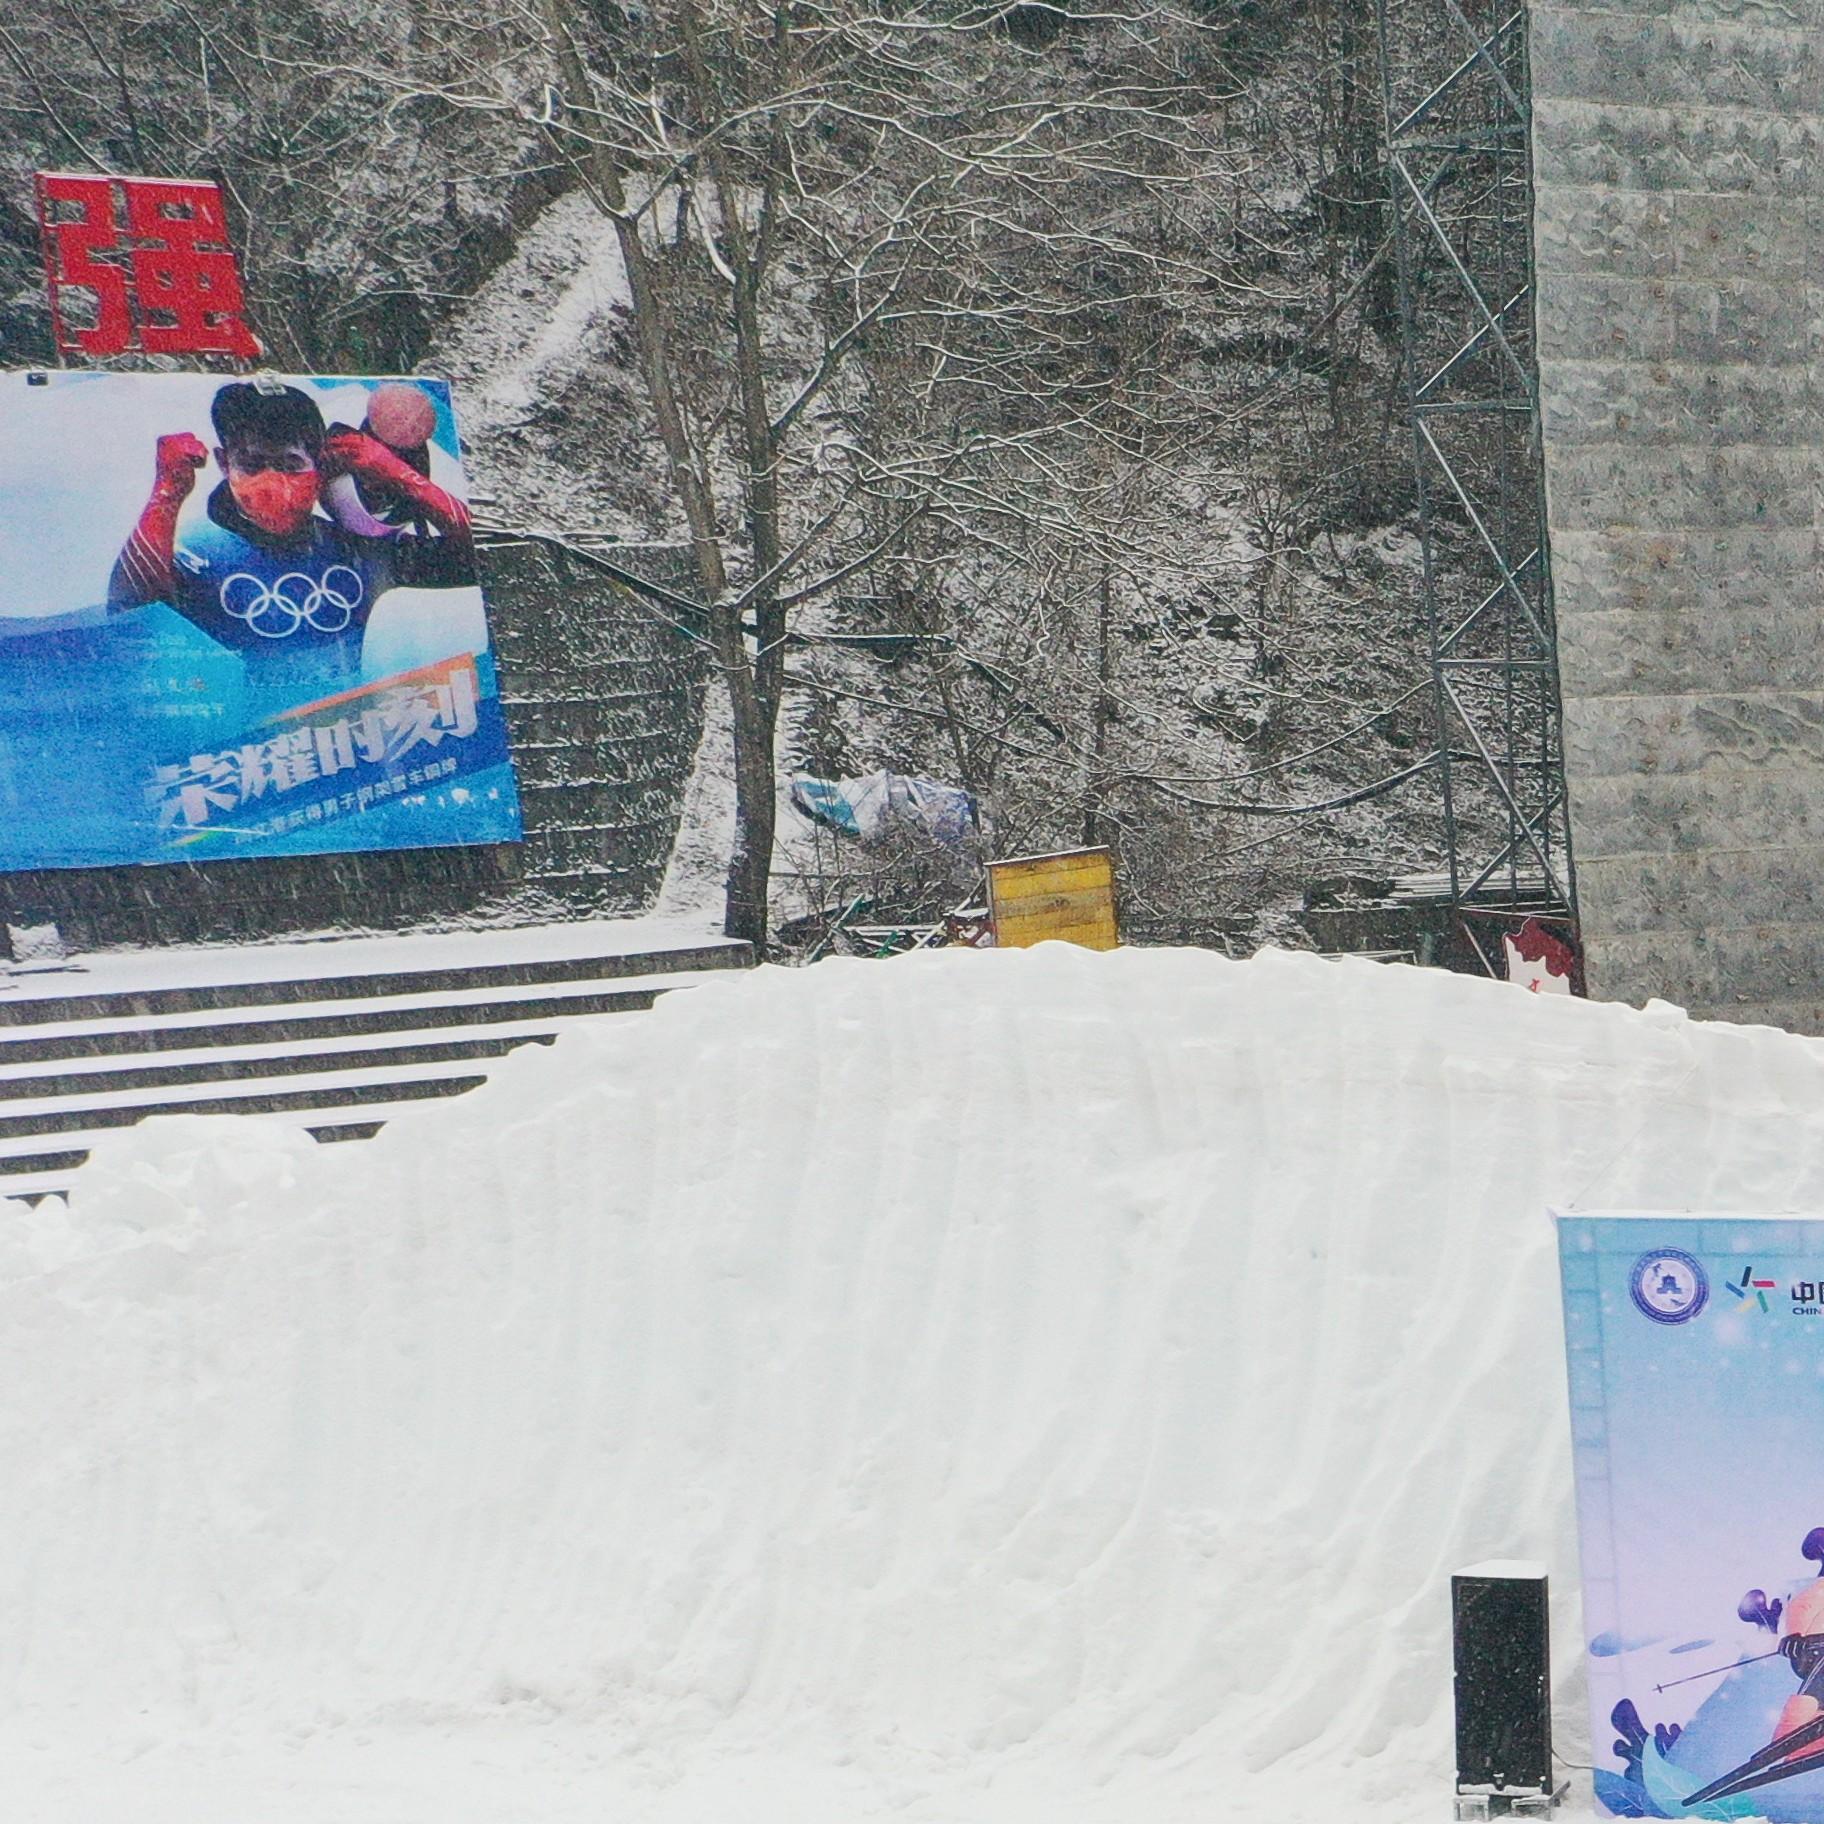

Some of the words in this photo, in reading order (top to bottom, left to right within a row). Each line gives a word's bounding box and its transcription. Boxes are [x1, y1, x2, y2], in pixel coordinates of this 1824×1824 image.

[36, 172, 262, 359] 强
[147, 669, 480, 829] 荣耀时刻
